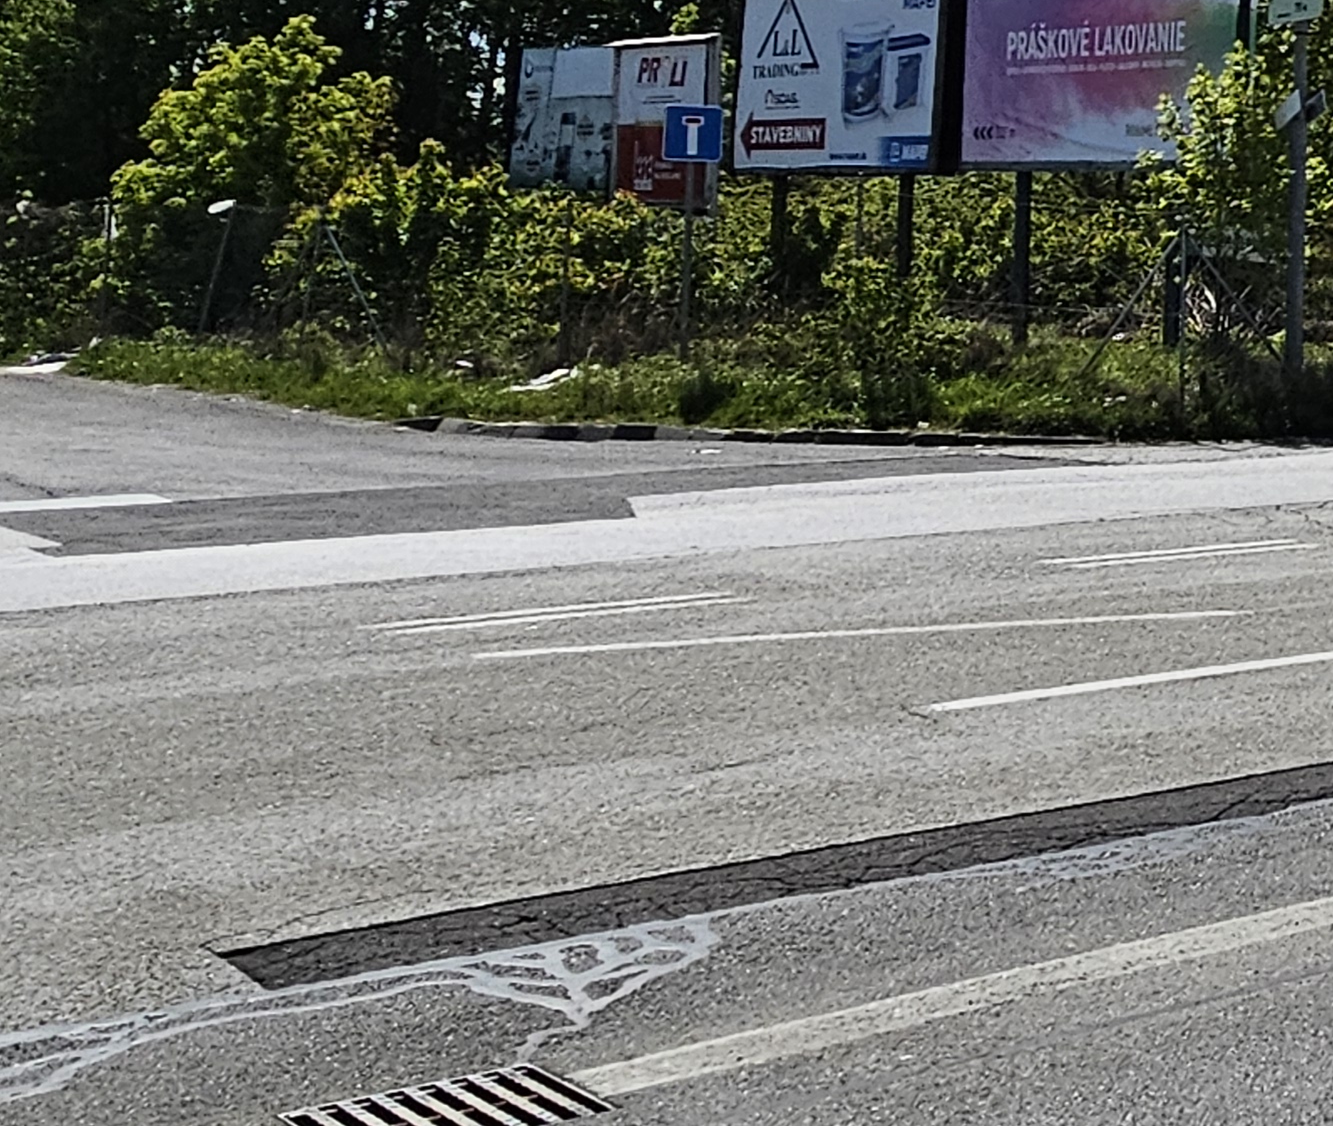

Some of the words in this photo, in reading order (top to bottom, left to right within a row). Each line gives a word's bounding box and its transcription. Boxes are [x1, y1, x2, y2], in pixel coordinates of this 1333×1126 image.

[1006, 20, 1090, 61] PRÁŠKOVÉ
[1094, 21, 1187, 57] LAKOVANIE
[636, 57, 689, 88] PRLI
[752, 64, 800, 80] TRADING
[750, 124, 823, 144] STAVEBNINY
